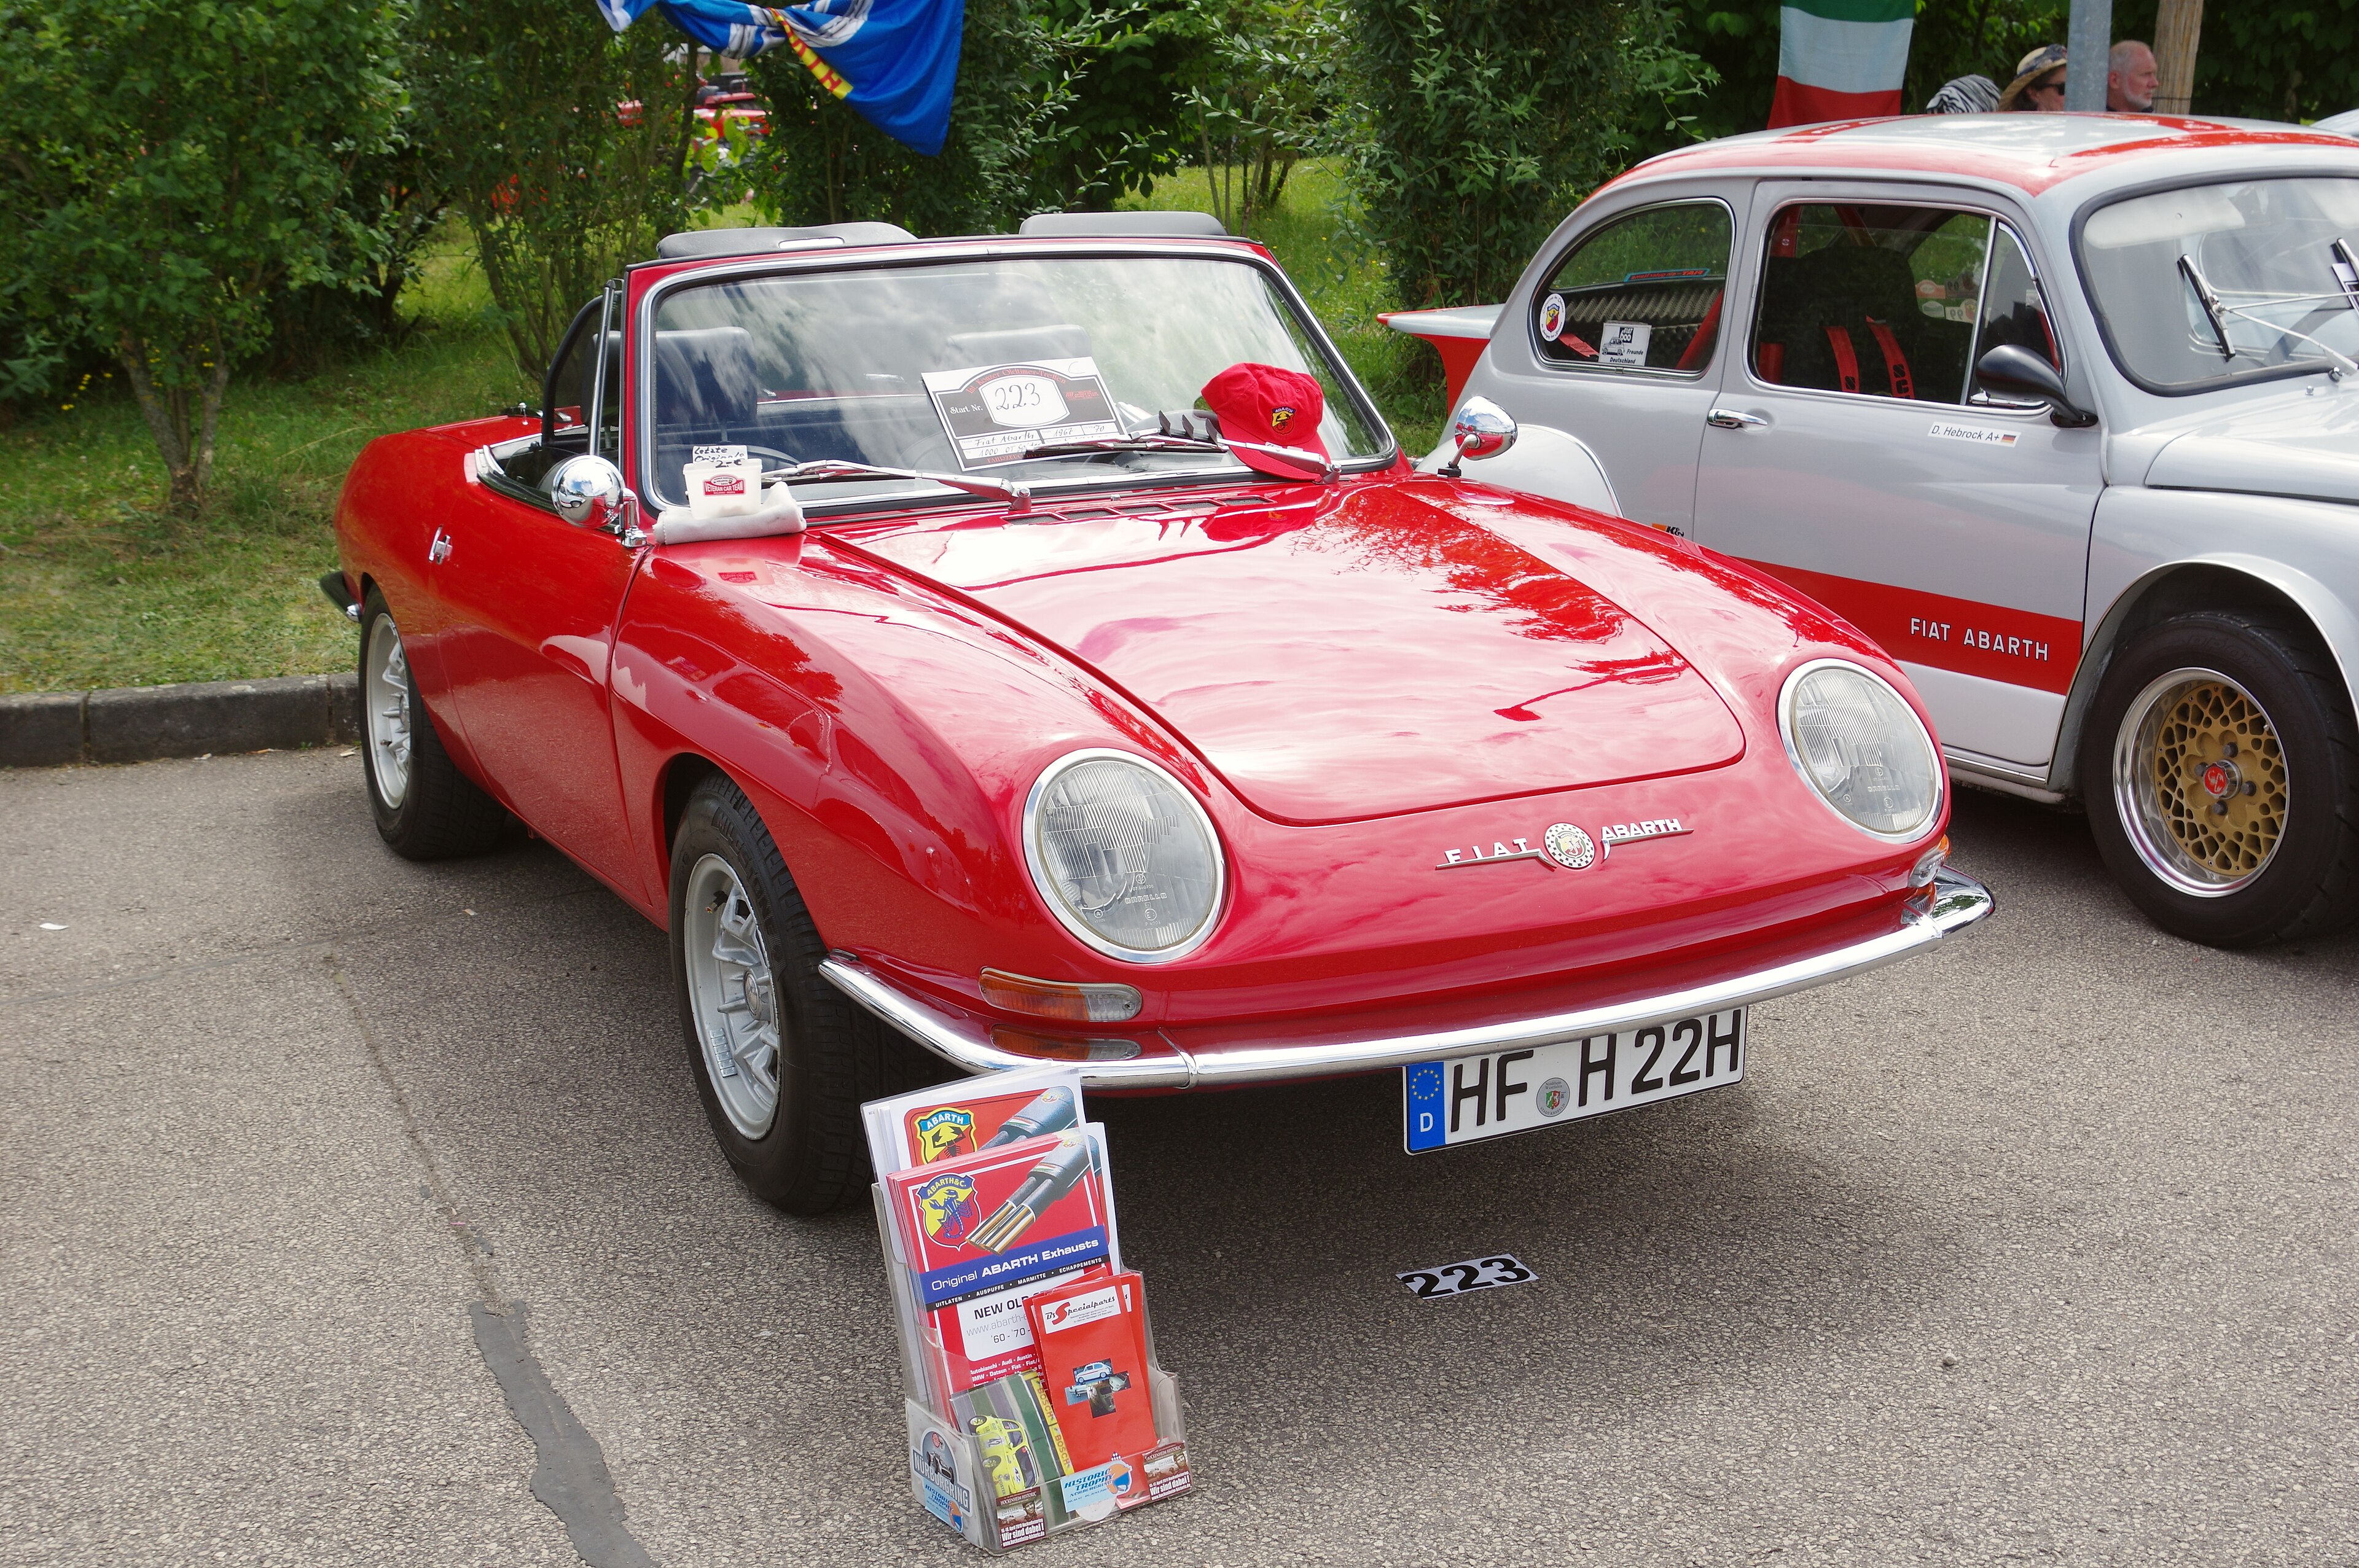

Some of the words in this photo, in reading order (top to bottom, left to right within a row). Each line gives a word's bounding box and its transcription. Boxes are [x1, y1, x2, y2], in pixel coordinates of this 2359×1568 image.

[1620, 330, 1631, 341] 600
[976, 372, 1001, 386] Konzer
[1001, 367, 1066, 384] Oldtimer-Treffen
[995, 383, 1041, 410] 223
[950, 405, 970, 415] Start
[975, 436, 996, 447] Fiat
[1000, 430, 1034, 443] Abarth
[1053, 428, 1073, 437] 1967
[1931, 425, 1940, 435] D.
[1943, 426, 1984, 440] Hebrock
[1985, 432, 2000, 441] A+
[979, 448, 998, 456] 1000
[704, 482, 723, 492] VETERAN
[732, 480, 743, 491] TEAM
[1911, 617, 1951, 641] FIAT
[1963, 628, 2048, 661] ABARTH
[1444, 837, 1528, 864] FIAT
[1602, 818, 1682, 840] ABARTH
[1450, 1049, 1534, 1133] HF
[1578, 1035, 1616, 1107] H
[1631, 1009, 1741, 1095] 22H
[927, 1114, 964, 1129] ABARTH
[1420, 1112, 1434, 1132] D
[927, 1177, 966, 1196] ABARTH&C.
[931, 1271, 977, 1290] Original
[982, 1254, 1039, 1277] ABARTH
[1042, 1239, 1099, 1261] Exhausts
[935, 1296, 963, 1308] UITLATEN
[976, 1284, 1004, 1297] AUSPUFFE
[1017, 1273, 1046, 1285] MARMITTE
[1059, 1258, 1102, 1273] ECHAPPEMENTS
[1401, 1258, 1530, 1297] 223
[974, 1303, 1003, 1319] NEW
[989, 1368, 1007, 1376] Datsun
[1038, 1388, 1054, 1418] BOSCH
[1055, 1434, 1071, 1465] BOSCH
[1167, 1445, 1181, 1454] HISTORIC
[914, 1454, 969, 1508] NÜRBURGRING
[1065, 1468, 1111, 1489] HISTORIC
[1076, 1473, 1115, 1491] TROPHY
[925, 1484, 951, 1504] HISTORIC
[1000, 1496, 1022, 1505] HOCKENHEIM
[1022, 1491, 1037, 1500] HISTORIC
[1150, 1486, 1160, 1496] Wir
[1160, 1482, 1172, 1492] sind
[931, 1494, 953, 1510] TROPHY
[1001, 1532, 1012, 1542] Wir
[1012, 1528, 1025, 1538] sind
